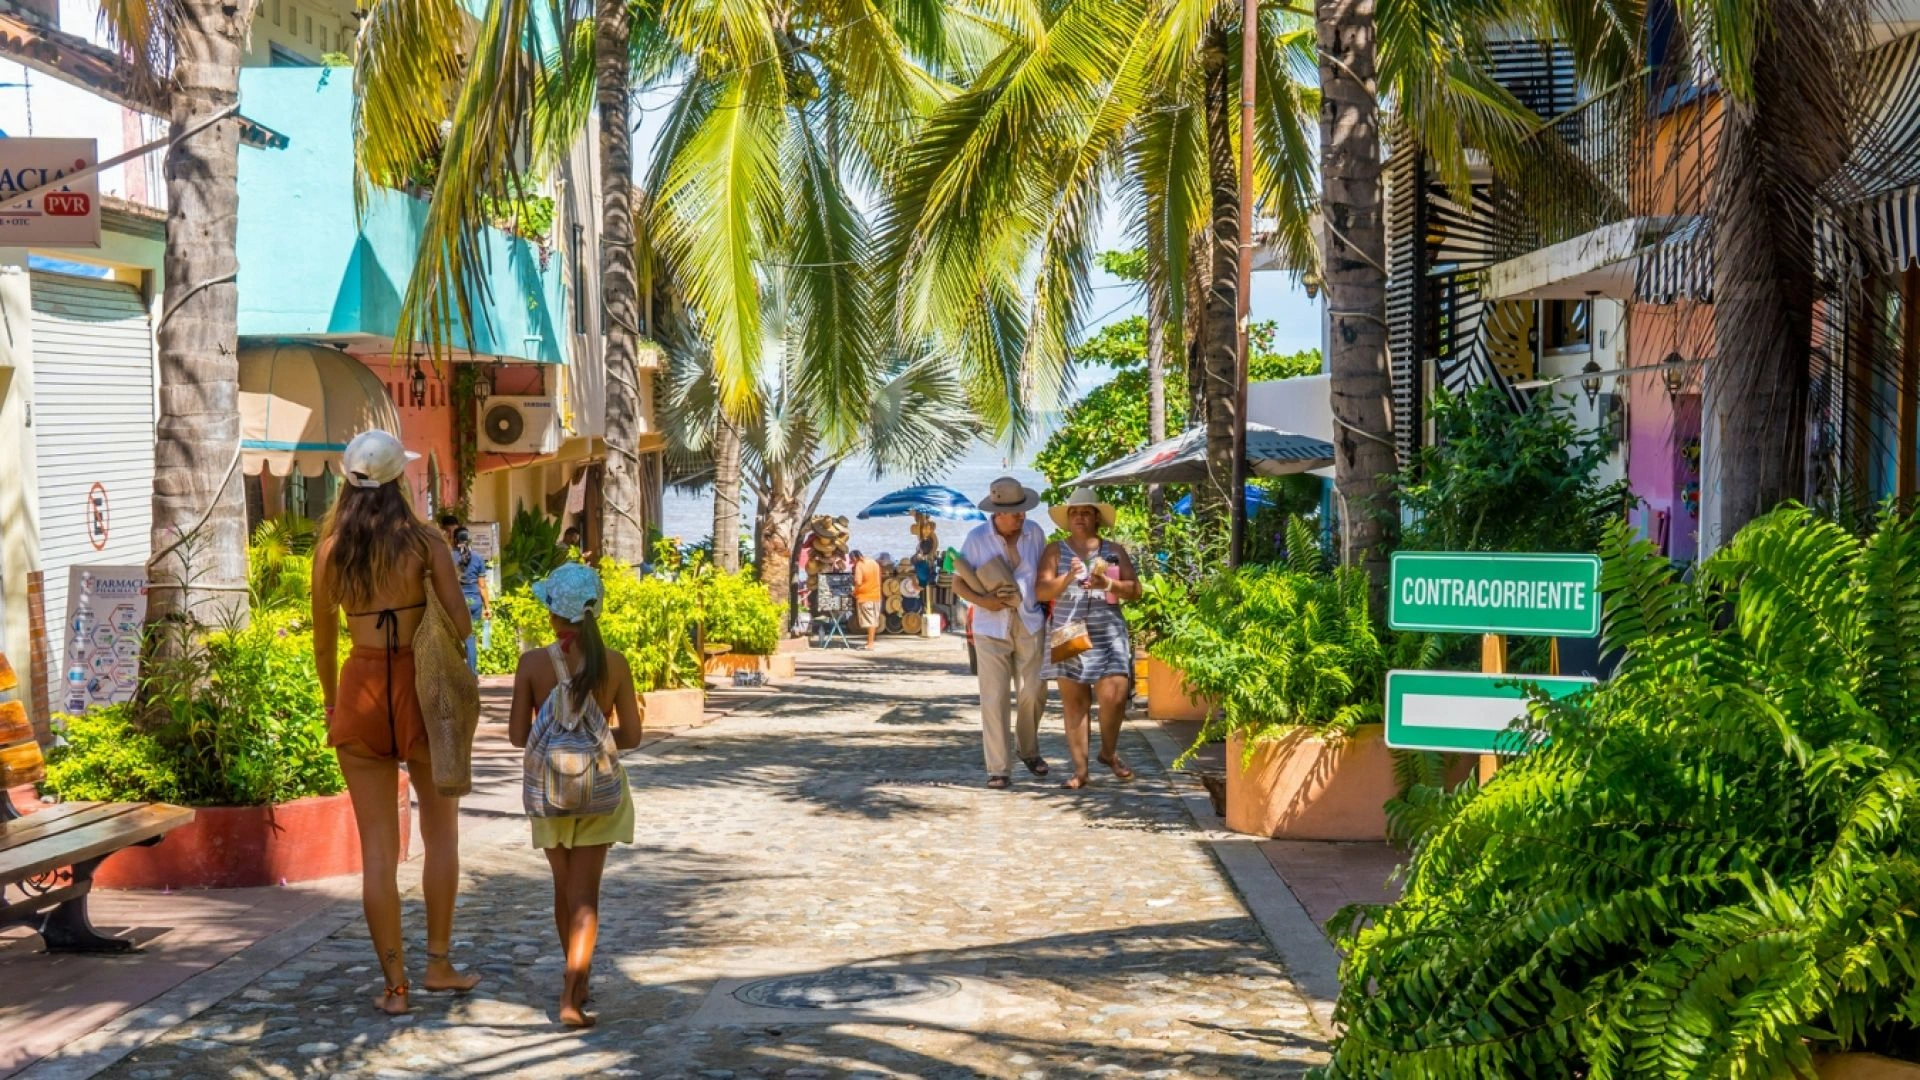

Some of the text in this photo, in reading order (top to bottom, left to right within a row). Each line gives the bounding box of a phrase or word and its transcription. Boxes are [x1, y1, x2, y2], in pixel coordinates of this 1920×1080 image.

[48, 196, 86, 213] PVR
[96, 579, 148, 588] FARMACI
[1402, 577, 1586, 611] CONTRACORRIENTE
